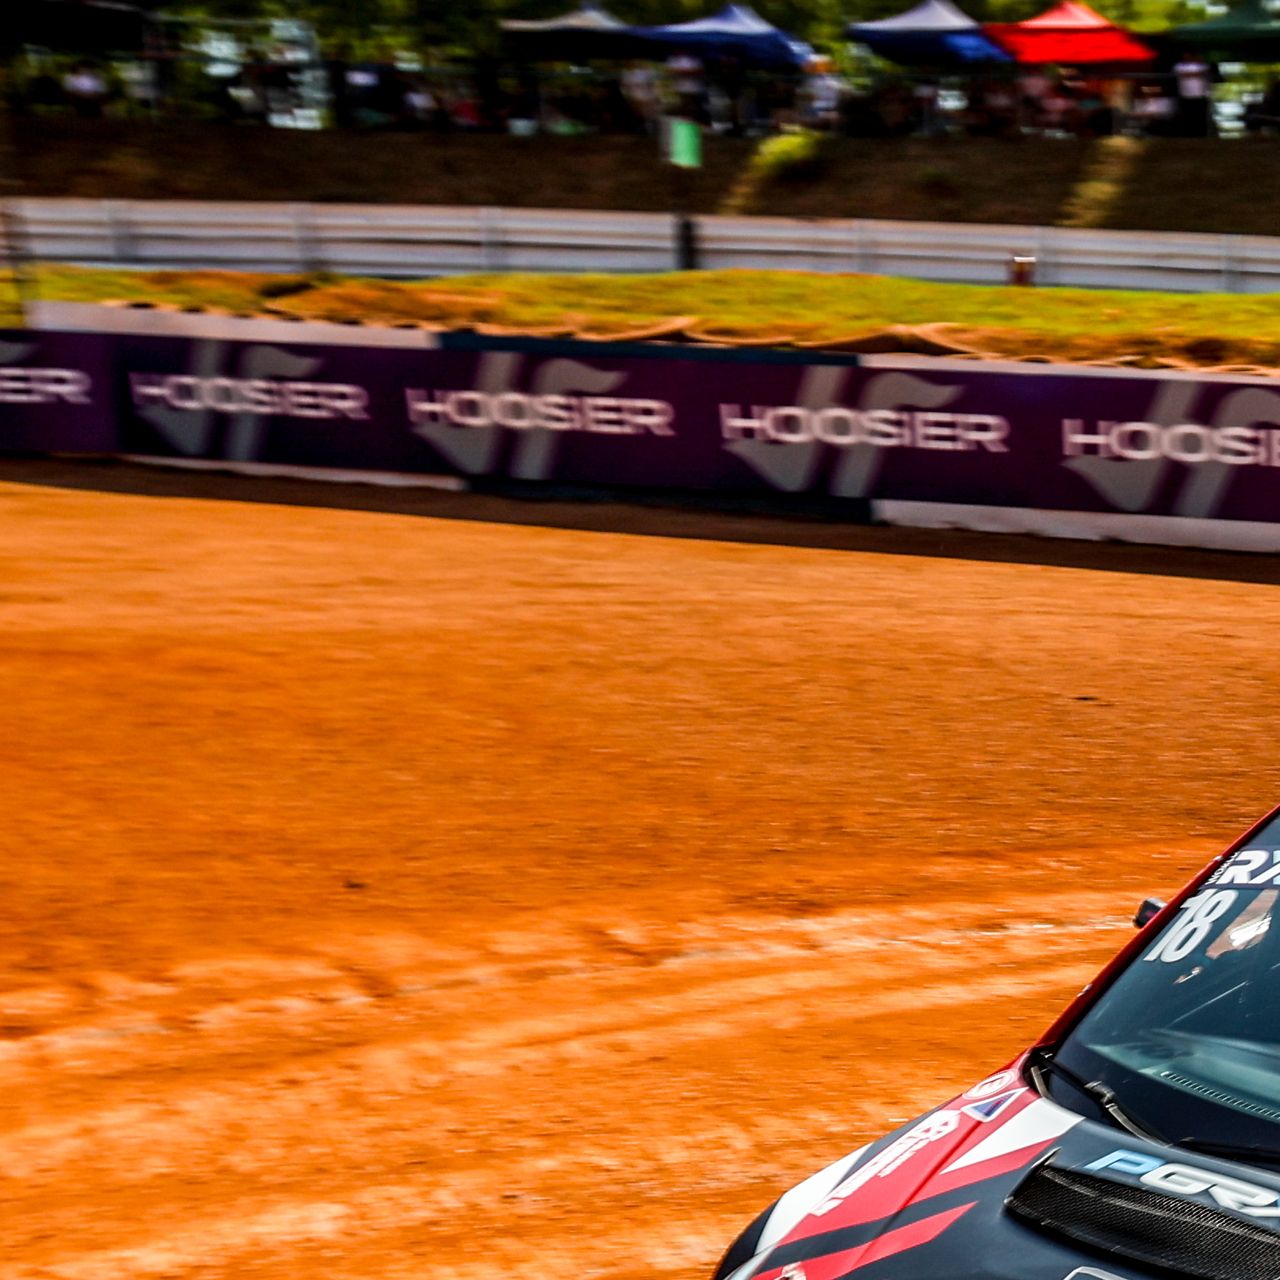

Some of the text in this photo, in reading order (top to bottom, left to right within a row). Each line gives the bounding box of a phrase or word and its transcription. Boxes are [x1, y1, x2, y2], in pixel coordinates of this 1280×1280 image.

[129, 371, 369, 421] HOOSIER
[404, 387, 676, 437] HOOSIER
[719, 403, 1009, 453] HOOSIER
[1142, 888, 1239, 963] 18
